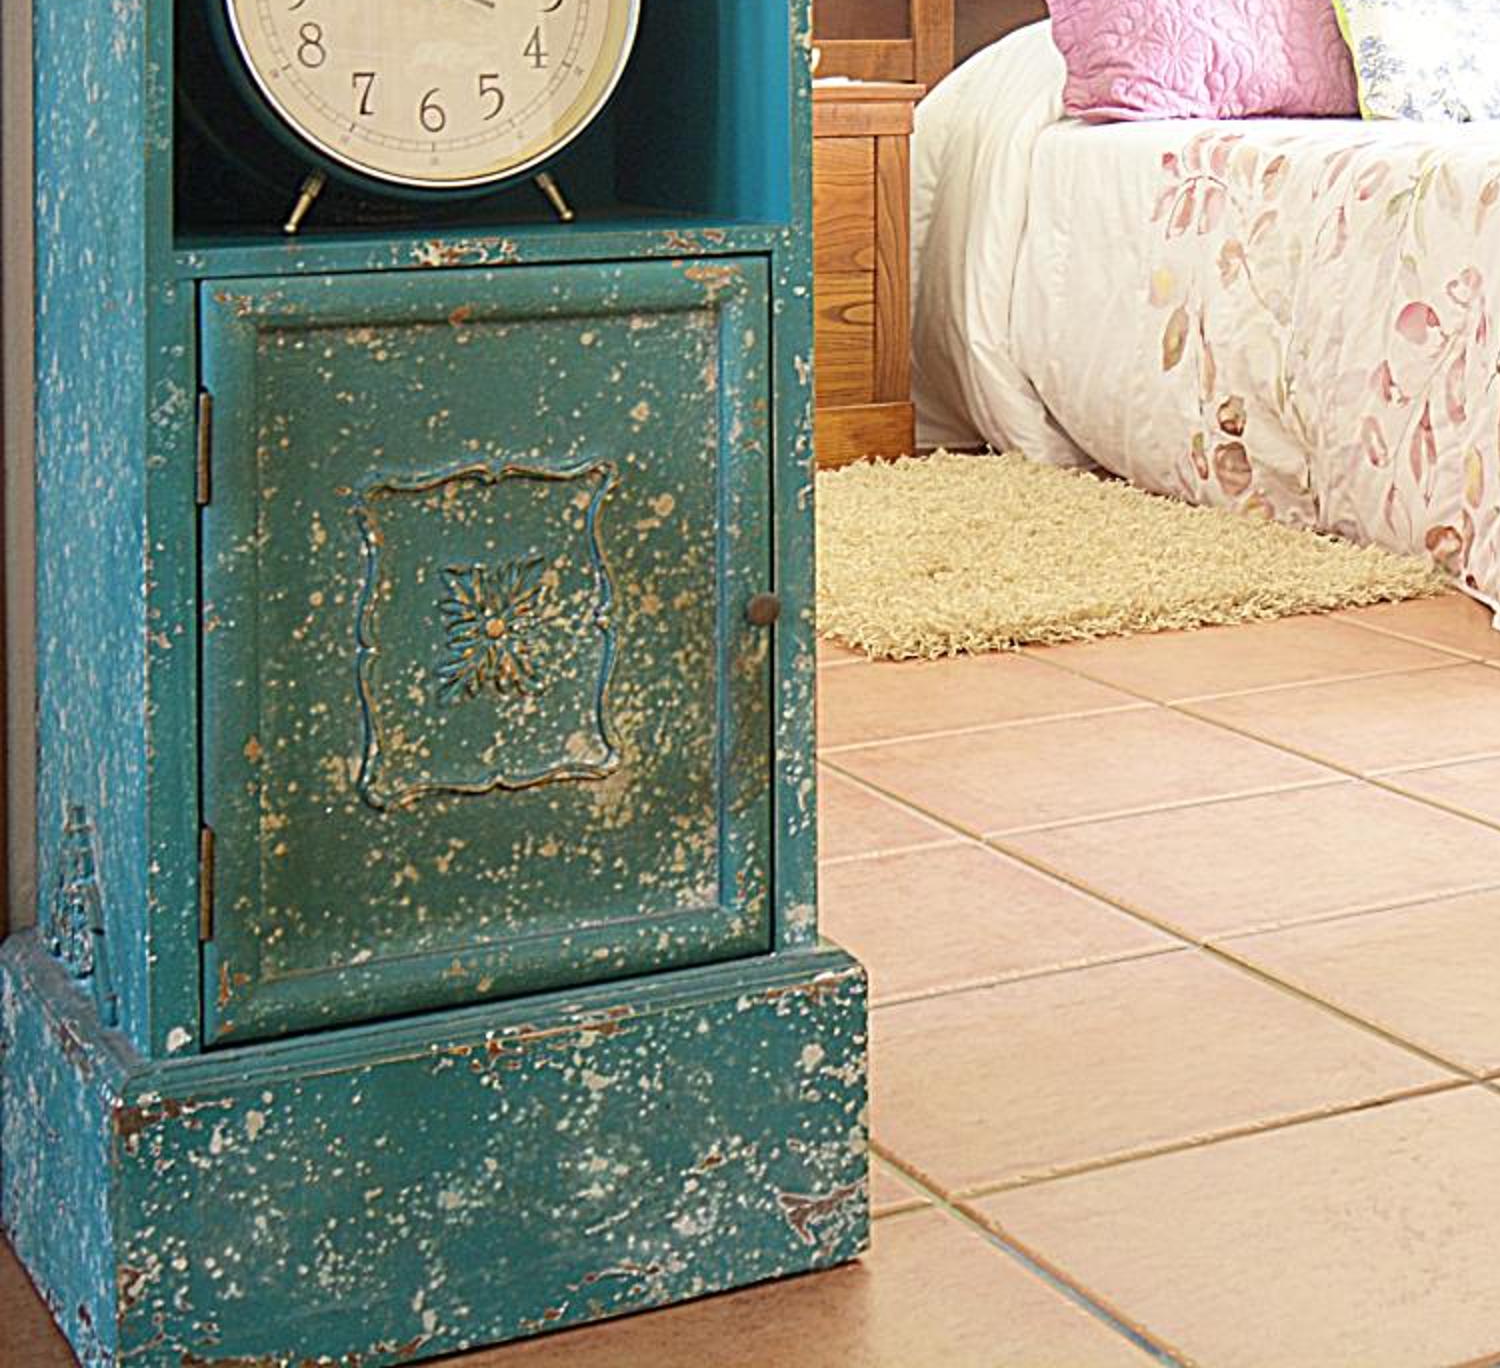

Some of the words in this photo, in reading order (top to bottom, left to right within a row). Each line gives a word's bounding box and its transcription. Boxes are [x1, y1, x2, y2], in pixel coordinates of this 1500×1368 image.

[297, 23, 326, 68] 8
[523, 25, 548, 69] 4
[351, 72, 376, 115] 7
[419, 88, 446, 132] 6
[478, 74, 504, 120] 5
